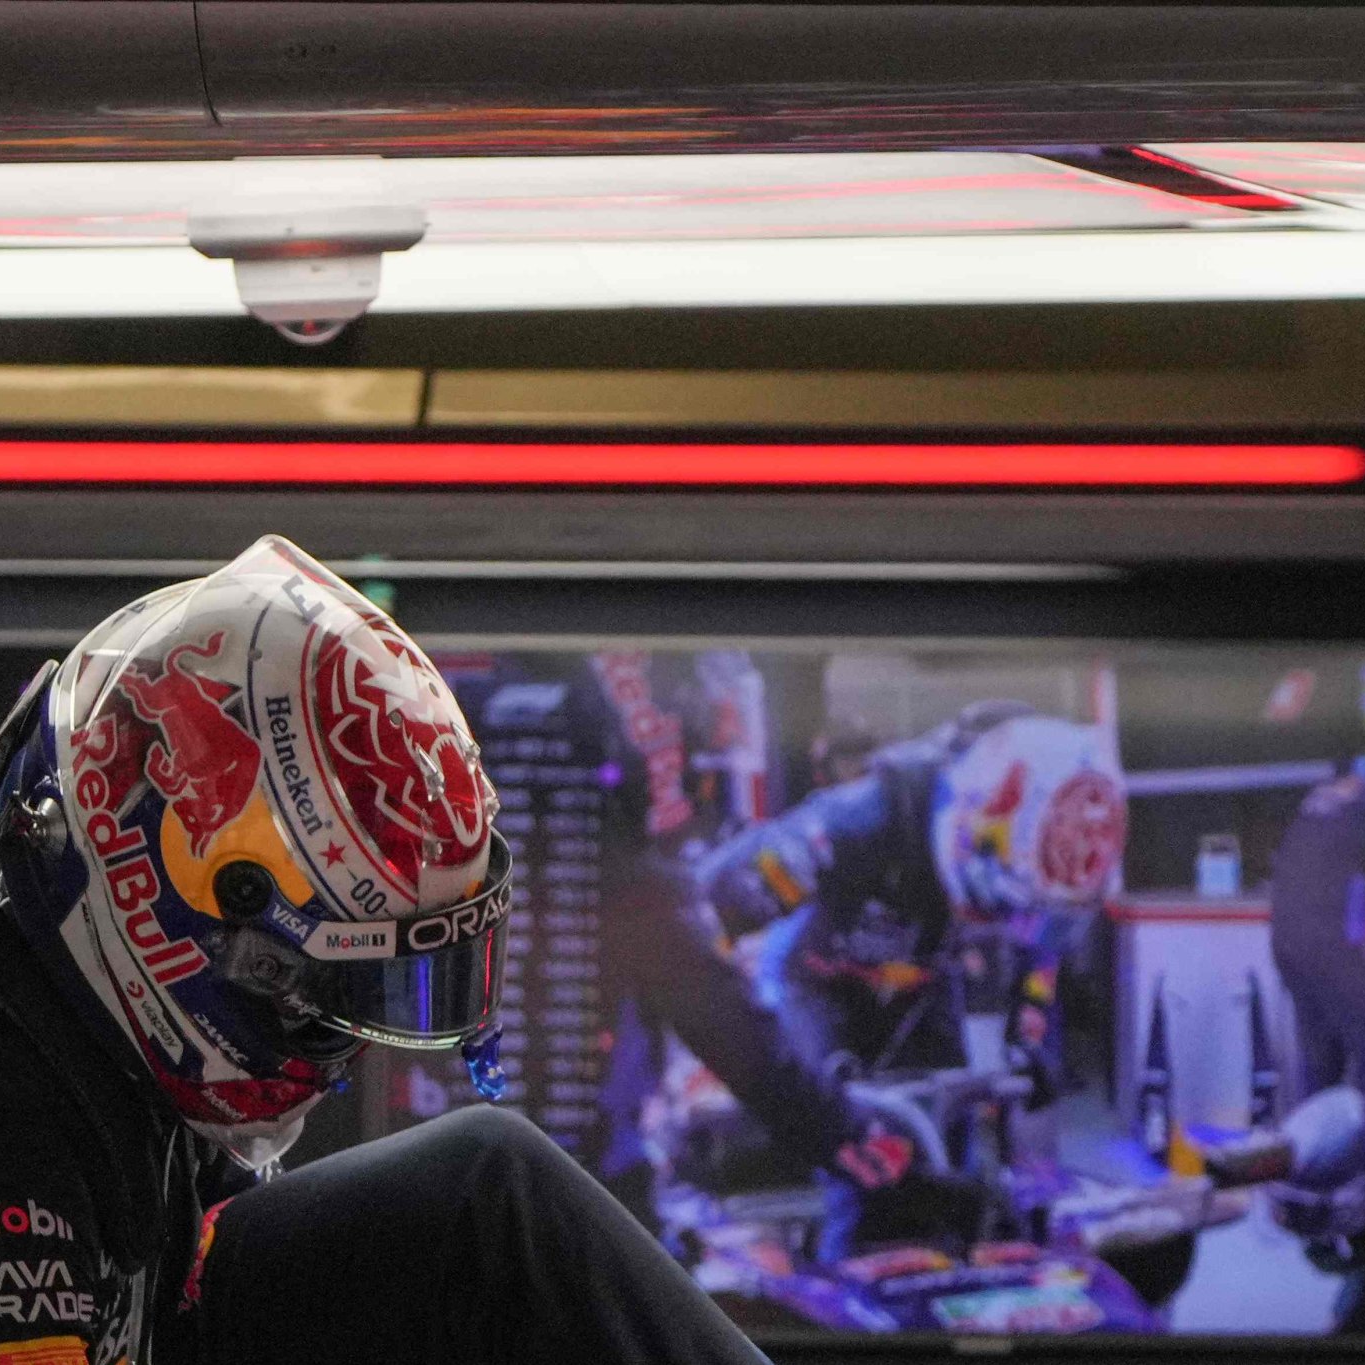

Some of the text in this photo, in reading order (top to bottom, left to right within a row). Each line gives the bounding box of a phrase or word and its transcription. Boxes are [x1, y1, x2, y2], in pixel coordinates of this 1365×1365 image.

[264, 696, 324, 836] Heineken
[271, 902, 312, 942] VISA
[326, 931, 369, 949] Mobil
[141, 1000, 178, 1049] viaplay
